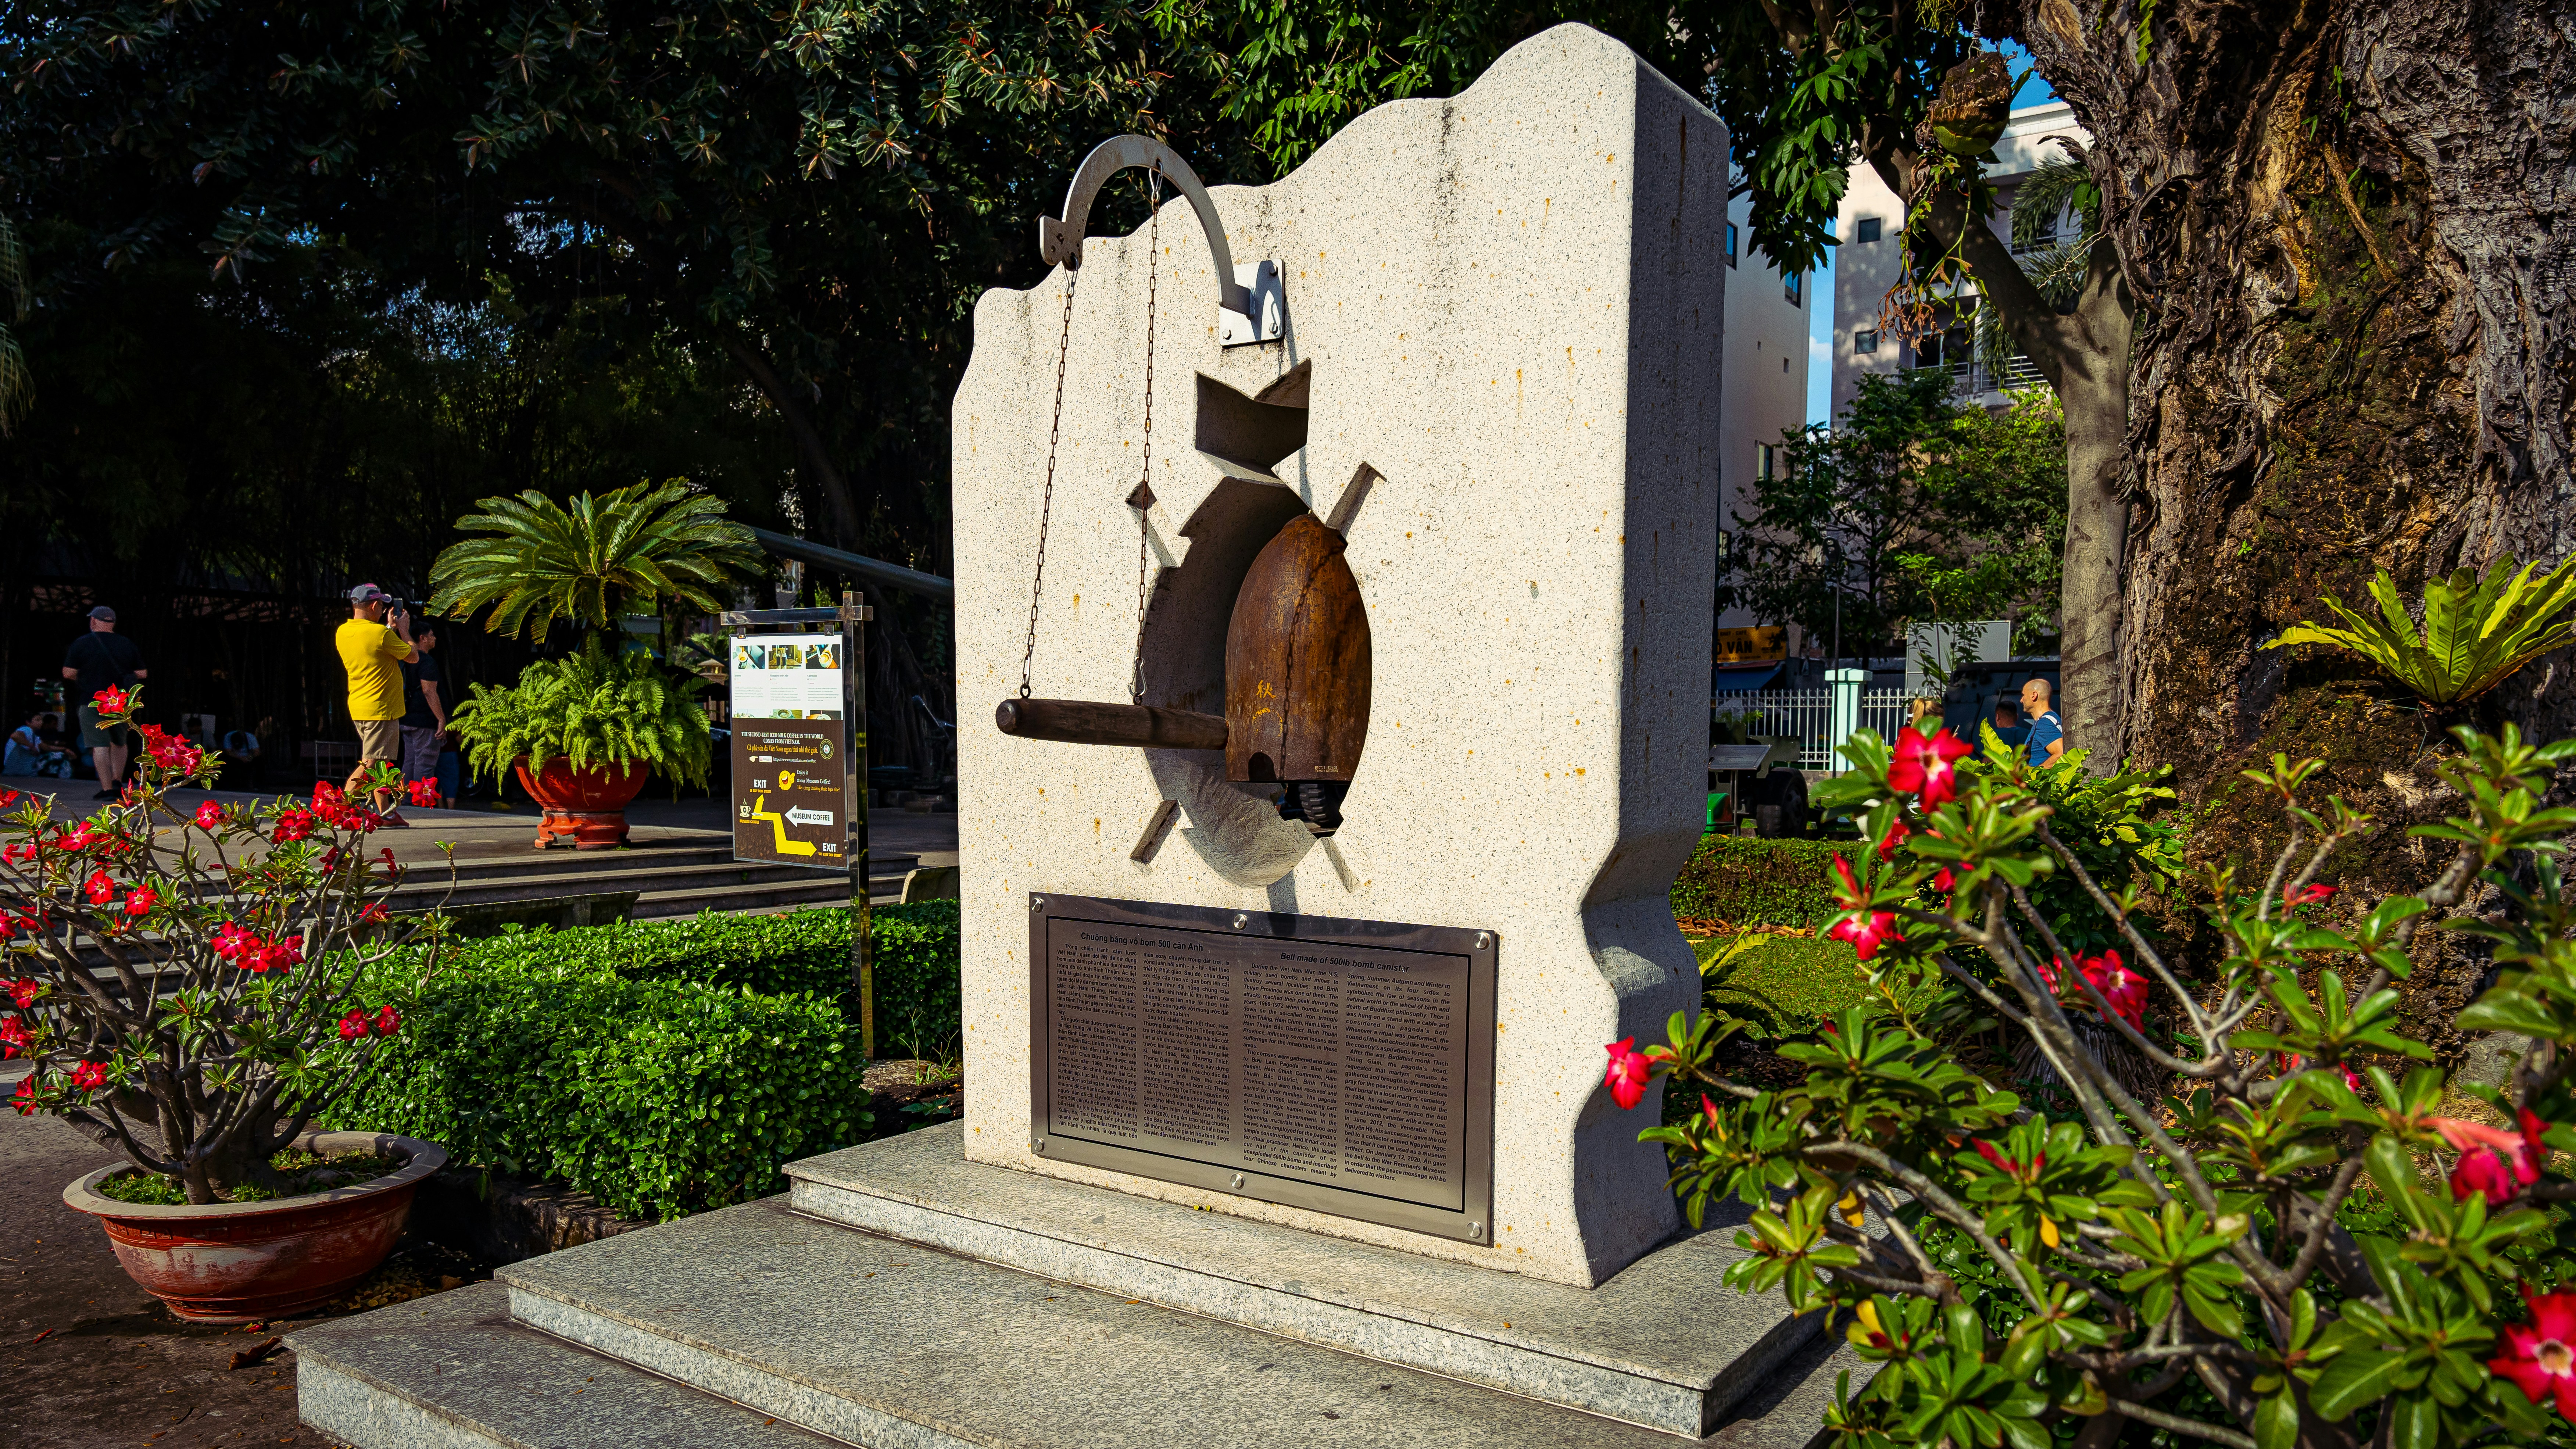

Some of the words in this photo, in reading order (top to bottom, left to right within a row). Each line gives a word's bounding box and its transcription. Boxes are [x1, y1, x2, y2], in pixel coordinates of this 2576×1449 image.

[1256, 680, 1276, 699] 秋
[754, 779, 767, 788] EXIT
[823, 842, 837, 852] EXIT
[1081, 932, 1108, 944] Chuông
[1110, 934, 1127, 946] bằng
[1140, 938, 1156, 947] bom
[1158, 940, 1171, 948] 500
[1173, 941, 1186, 950] cân
[1188, 943, 1203, 951] Anh
[1280, 952, 1295, 961] Bell
[1296, 955, 1318, 963] made
[1329, 957, 1350, 966] 500lb
[1352, 959, 1374, 969] bomb
[1377, 963, 1410, 972] canister
[1347, 981, 1379, 989] Vietnamese
[1400, 1124, 1427, 1133] Venerable
[1257, 1158, 1277, 1166] Chinese
[1280, 1163, 1307, 1172] characters
[1393, 1160, 1421, 1170] Remnants
[1422, 1166, 1446, 1175] Museum
[1345, 1167, 1369, 1176] delivered
[1375, 1173, 1396, 1181] visitors.
